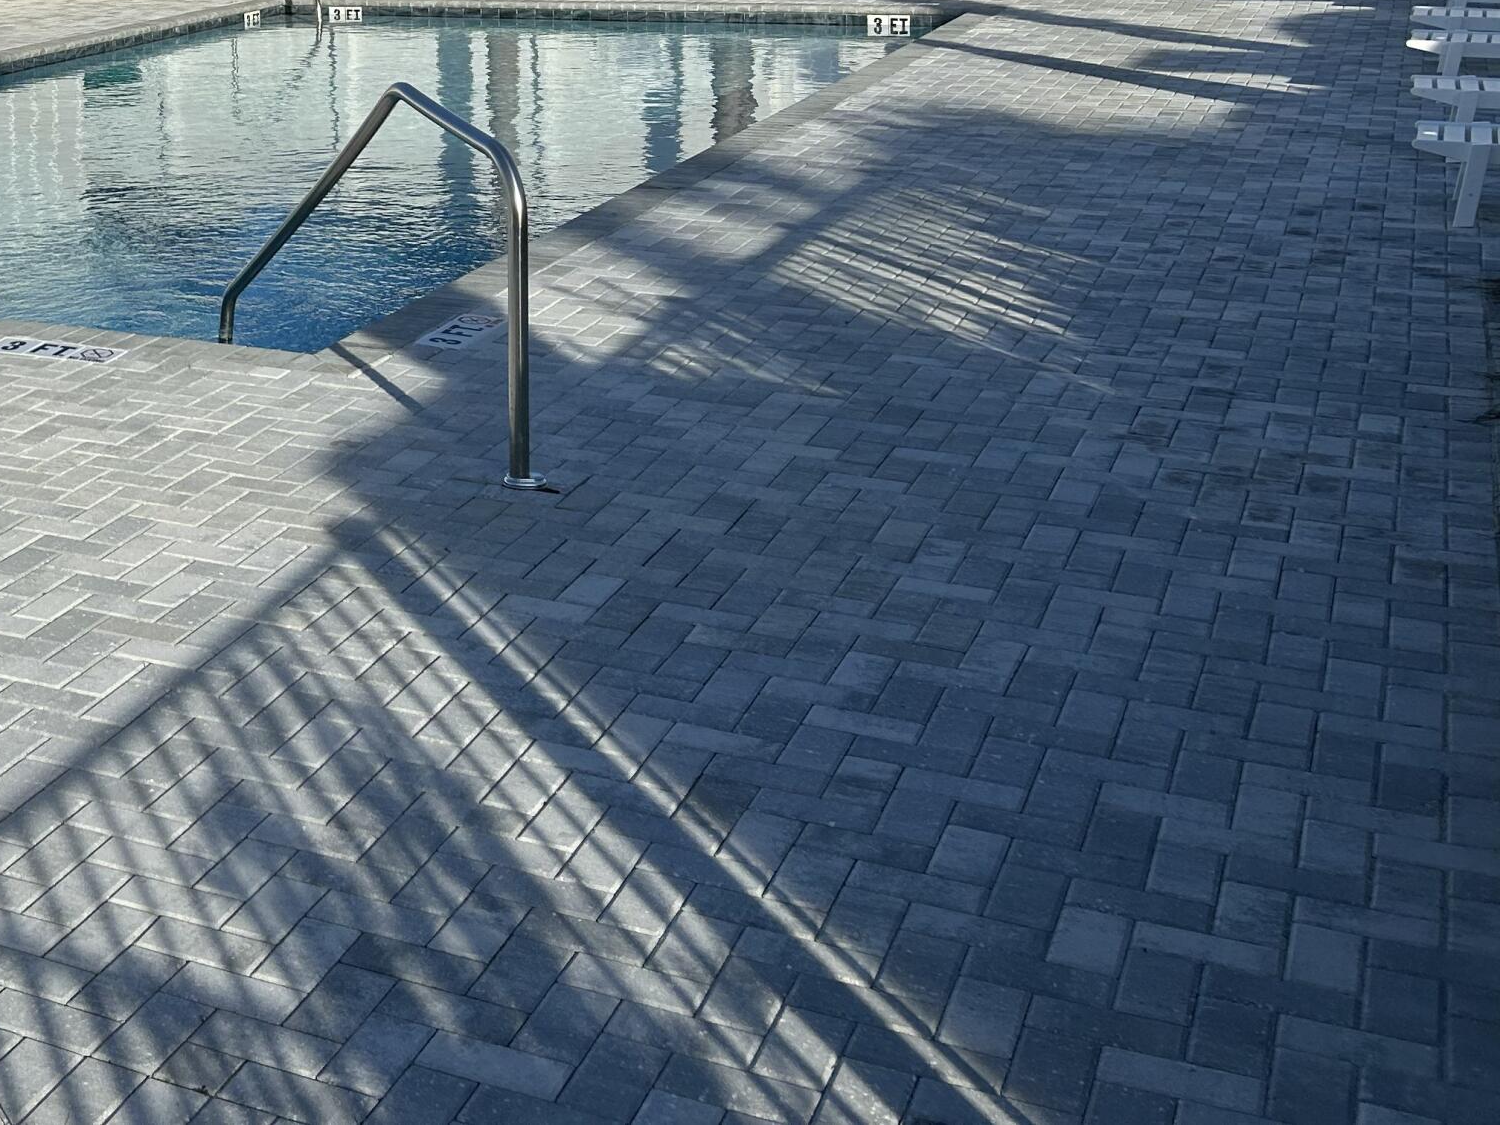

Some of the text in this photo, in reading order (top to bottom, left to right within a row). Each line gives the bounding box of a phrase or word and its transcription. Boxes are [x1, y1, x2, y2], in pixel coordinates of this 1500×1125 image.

[334, 8, 341, 21] 3
[873, 17, 883, 34] 3
[1, 340, 27, 351] 3
